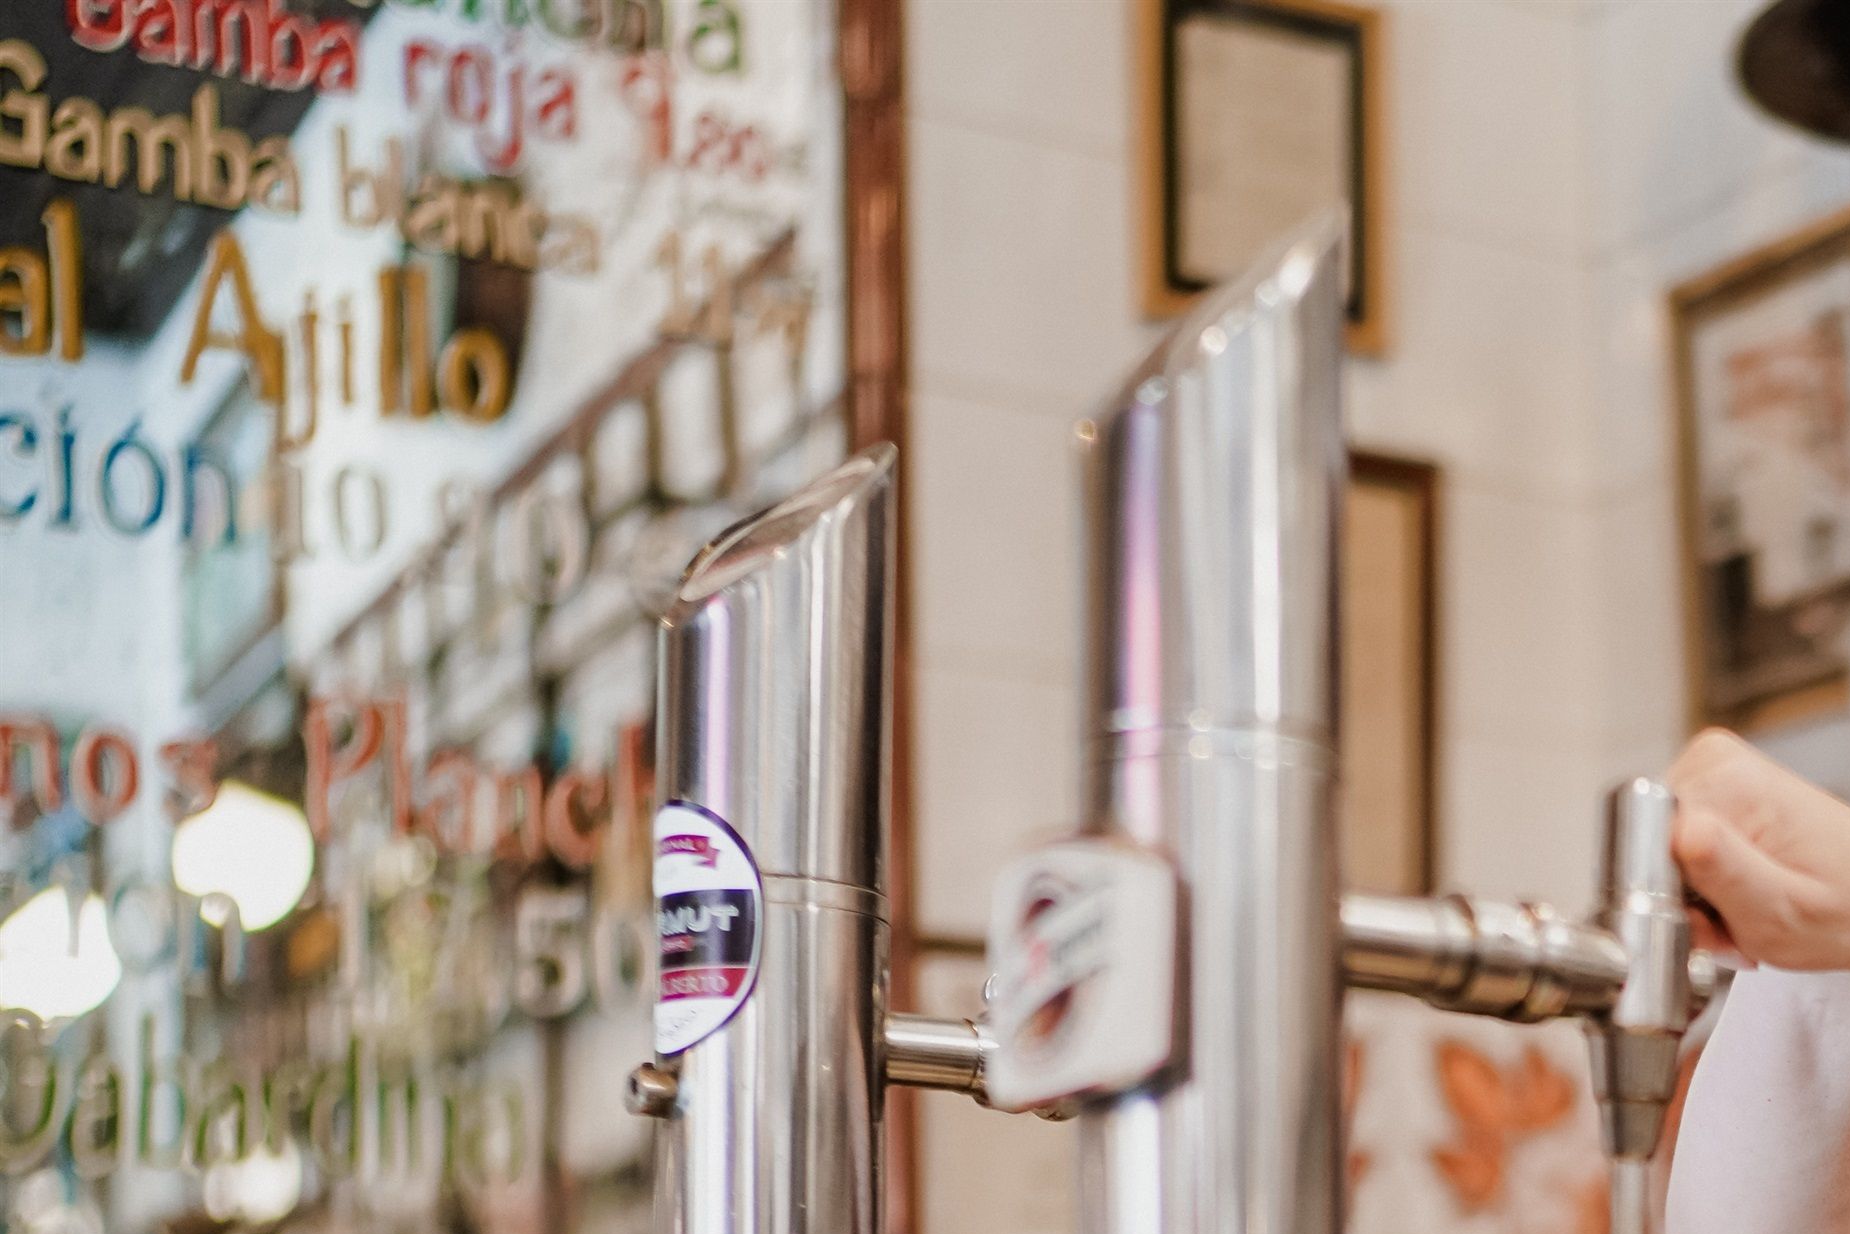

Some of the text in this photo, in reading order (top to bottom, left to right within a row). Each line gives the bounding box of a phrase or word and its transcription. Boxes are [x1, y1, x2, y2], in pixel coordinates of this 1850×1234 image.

[402, 40, 577, 170] roja
[332, 124, 602, 272] blanca
[180, 228, 512, 450] Ajillo
